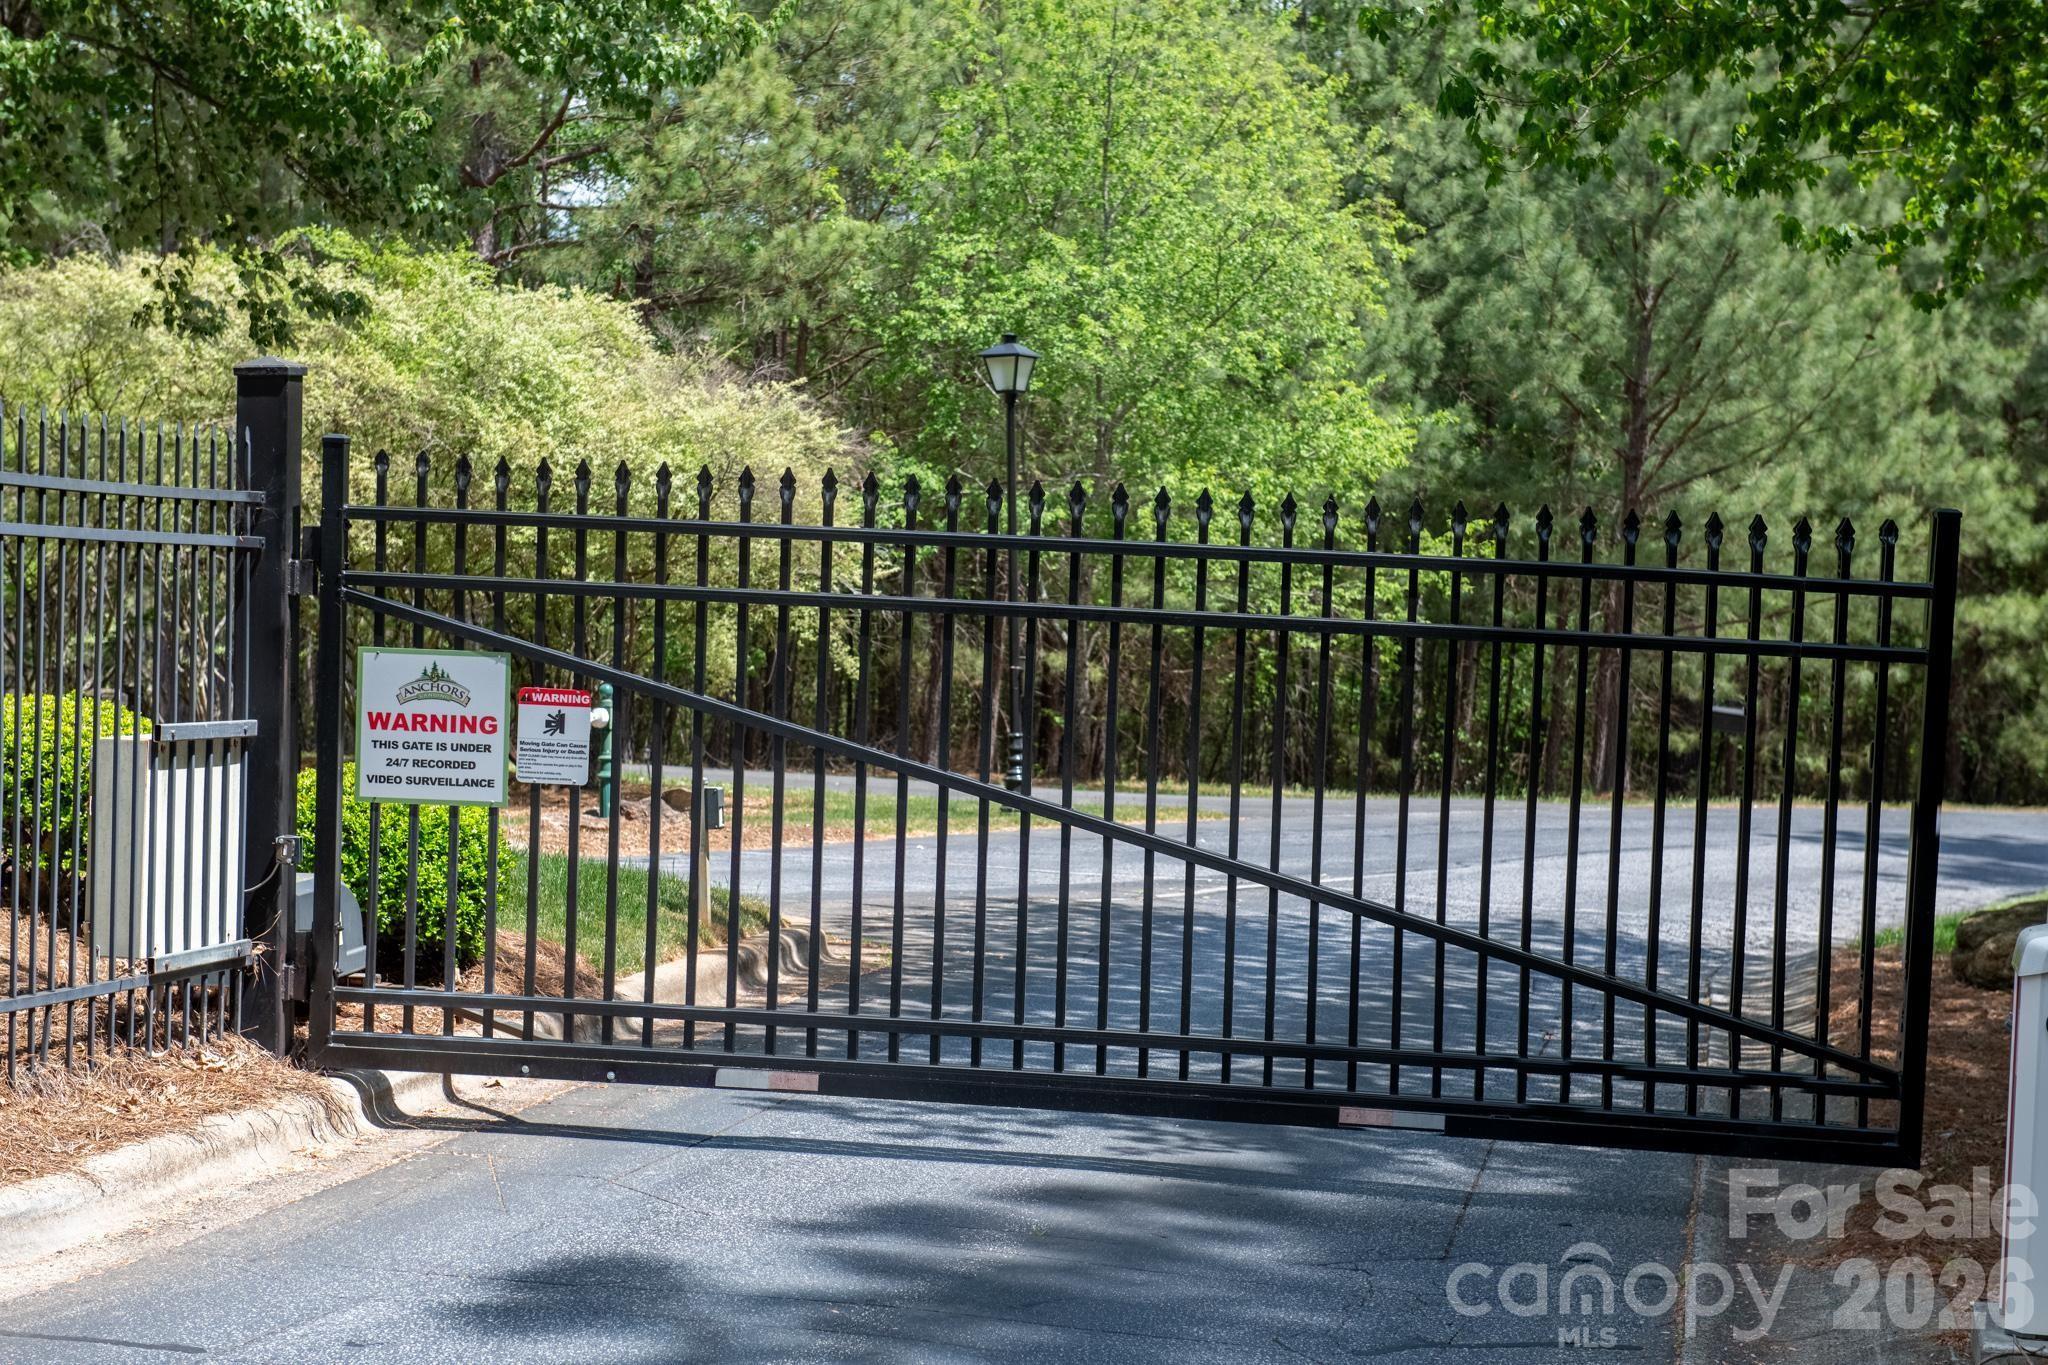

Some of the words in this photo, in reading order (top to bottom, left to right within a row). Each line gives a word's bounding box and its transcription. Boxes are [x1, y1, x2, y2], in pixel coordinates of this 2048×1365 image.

[404, 683, 465, 699] ANCHORS
[531, 693, 590, 704] WARNING
[367, 712, 498, 734] WARNING
[371, 740, 399, 750] THIS
[402, 741, 433, 751] GATE
[436, 742, 447, 751] IS
[451, 743, 492, 753] UNDER
[386, 758, 409, 767] 24/7
[412, 759, 476, 770] RECORDED
[366, 774, 402, 785] VIDEO
[405, 776, 495, 788] SURVEILLANCE
